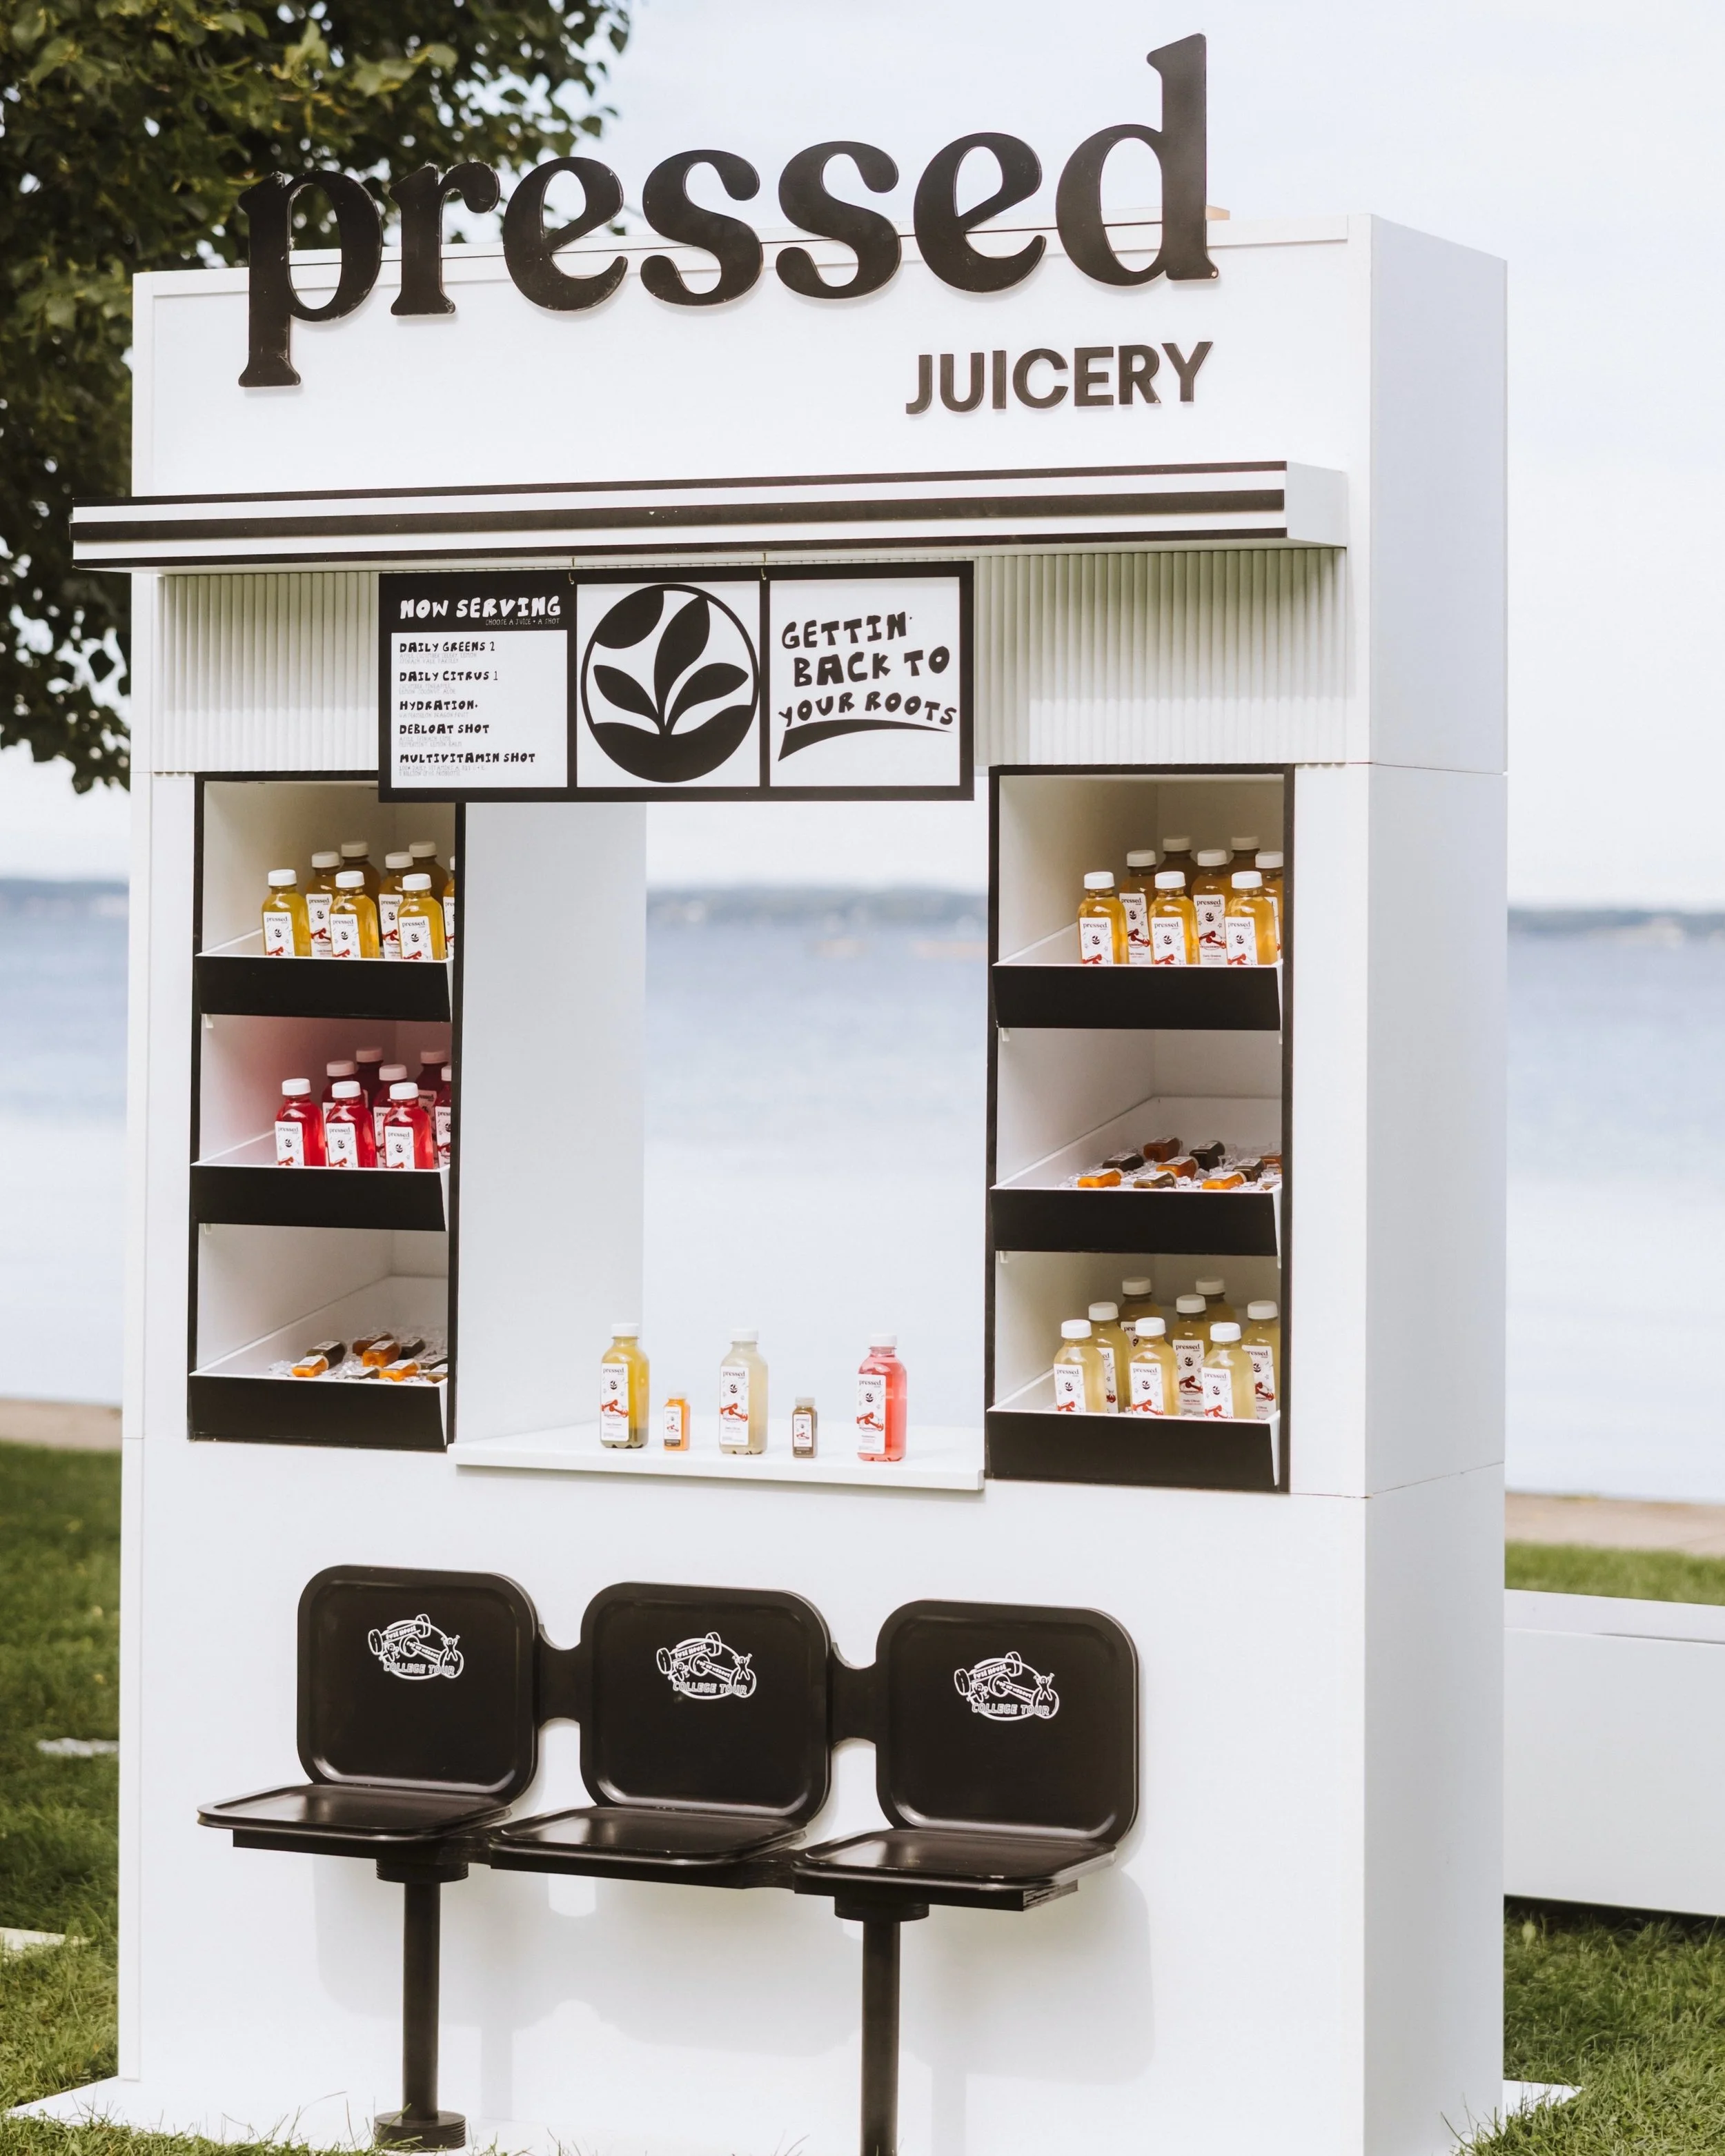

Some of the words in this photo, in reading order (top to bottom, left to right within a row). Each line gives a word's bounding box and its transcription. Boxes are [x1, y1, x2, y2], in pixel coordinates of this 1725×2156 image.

[238, 33, 1219, 388] pressed
[906, 342, 1213, 414] JUICERY
[400, 599, 448, 620] NOW
[456, 595, 561, 618] SERVING
[400, 642, 439, 653] DAILY
[443, 642, 486, 652] GREENS
[489, 641, 495, 651] 2
[794, 651, 891, 687] BACK
[903, 645, 950, 677] TO
[400, 671, 439, 682] DAILY
[442, 671, 489, 682] CITRUS
[778, 691, 855, 728] YOUR
[865, 691, 957, 725] ROOTS
[400, 724, 454, 734] DEBLOAT
[457, 724, 490, 734] SHOT
[400, 753, 500, 763] MULTIVITAMIN
[503, 753, 535, 763] SHOT
[384, 1661, 426, 1674] COLLEGE
[428, 1663, 455, 1676] TOUR
[673, 1681, 717, 1693] COLLEGE
[719, 1683, 747, 1695] TOUR
[972, 1703, 1018, 1714] COLLEGE
[1021, 1705, 1050, 1716] TOUR
